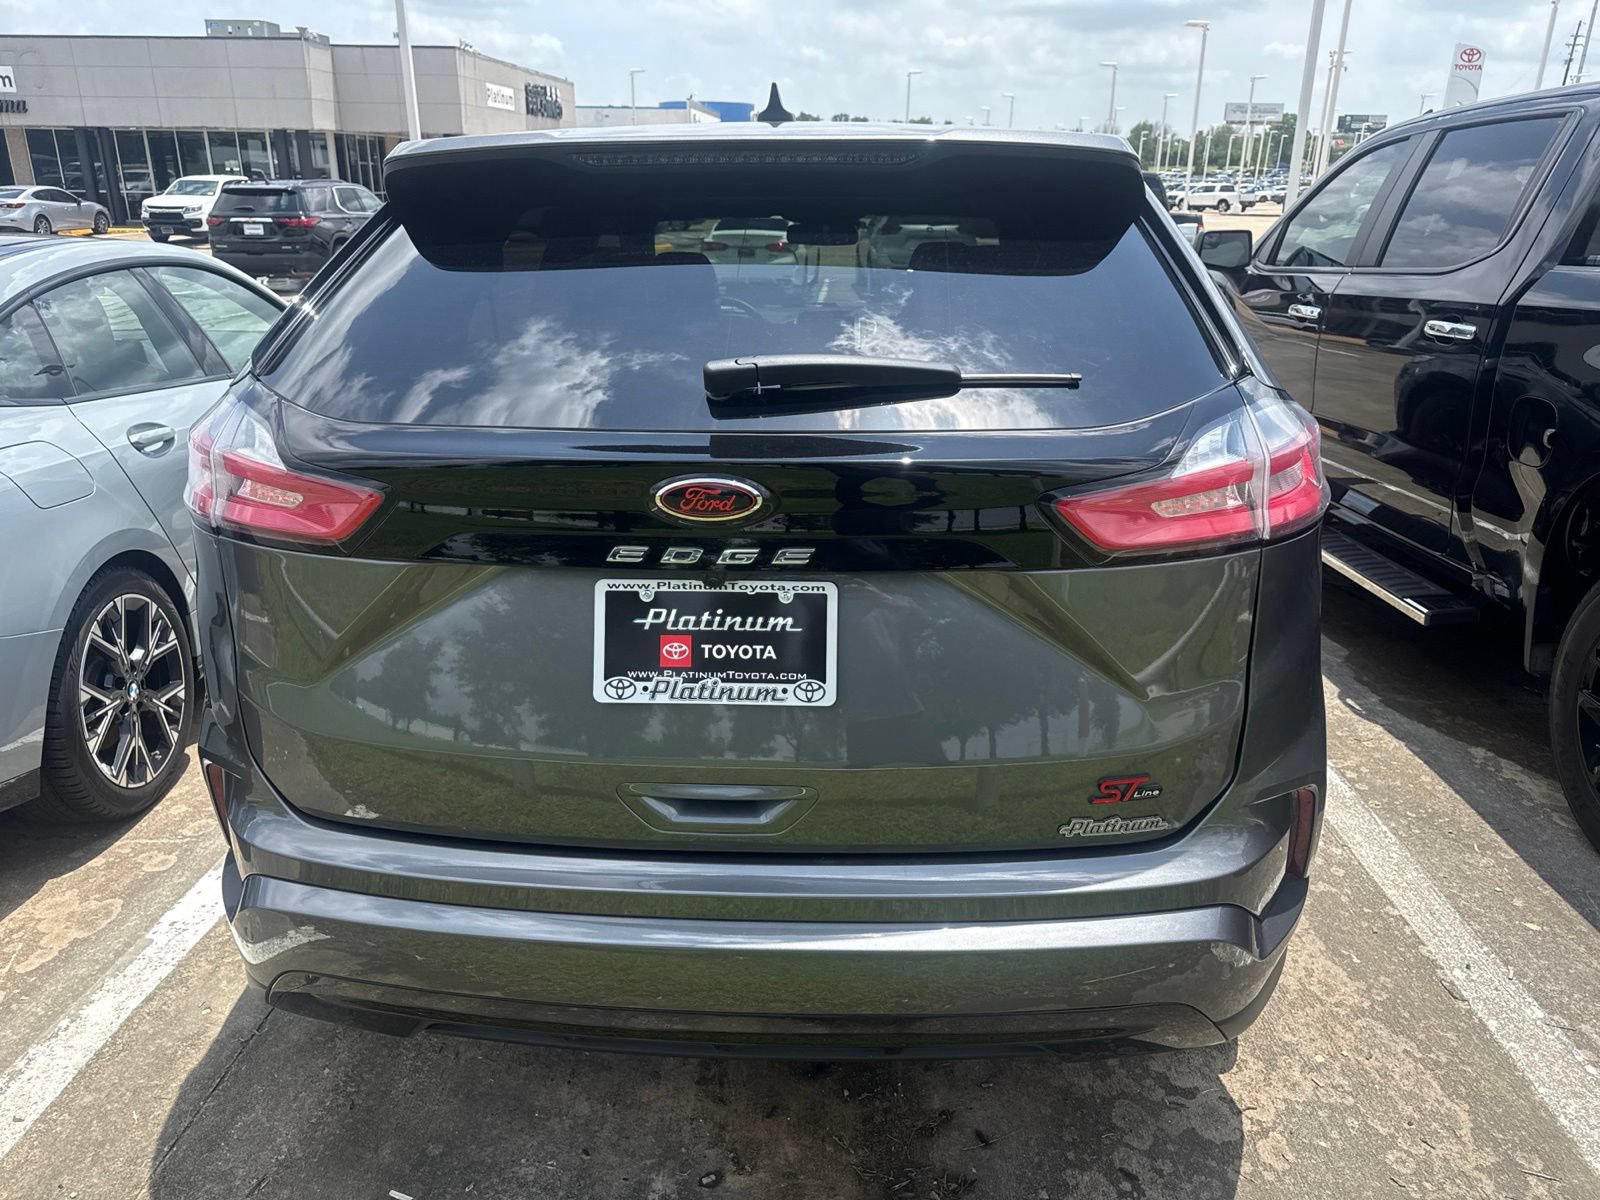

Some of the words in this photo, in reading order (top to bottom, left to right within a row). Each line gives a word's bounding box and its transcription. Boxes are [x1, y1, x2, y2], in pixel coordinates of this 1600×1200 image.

[679, 487, 736, 511] Ford
[605, 545, 817, 565] EDGE
[632, 608, 803, 632] Platinum
[701, 644, 777, 660] TOYOTA
[648, 678, 788, 702] Platinum
[1091, 775, 1150, 804] ST
[1133, 789, 1160, 798] Line
[1058, 815, 1169, 837] Platinum
